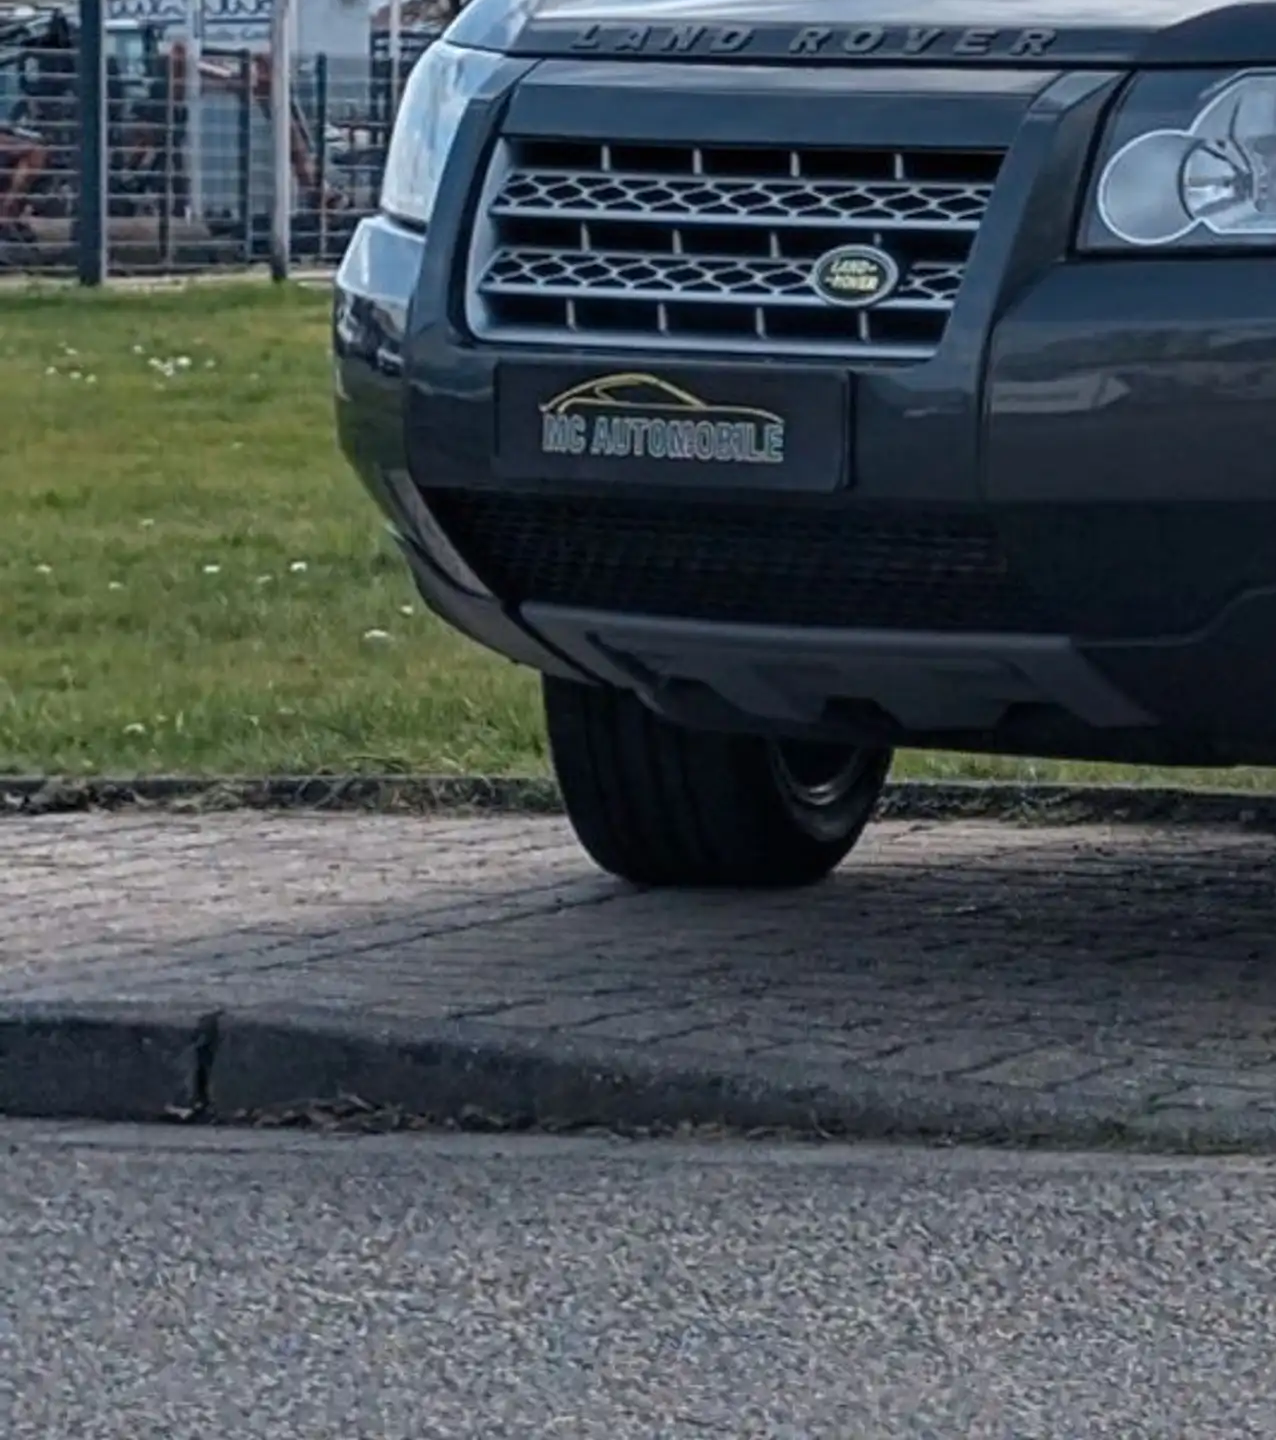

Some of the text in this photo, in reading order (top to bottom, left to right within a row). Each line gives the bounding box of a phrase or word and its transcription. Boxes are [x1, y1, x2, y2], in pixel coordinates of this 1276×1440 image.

[570, 24, 1058, 57] LAND ROVER
[542, 414, 784, 463] MC AUTOMOBILE
